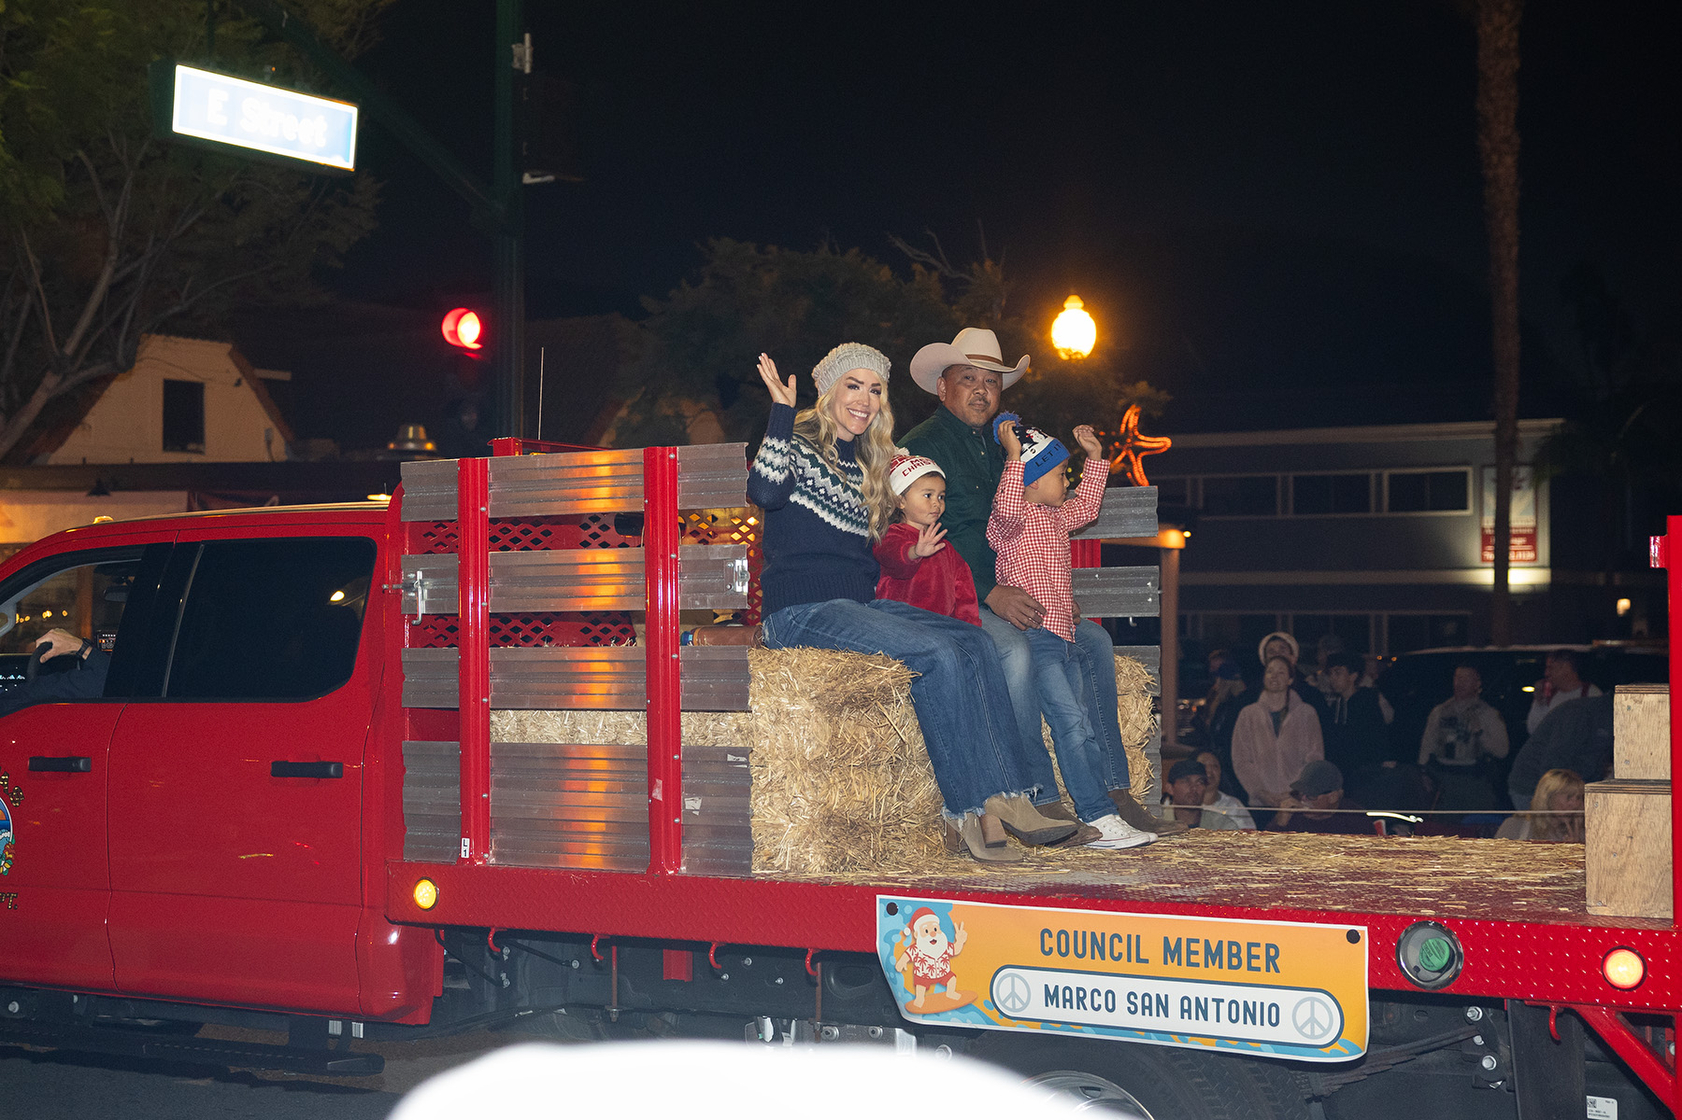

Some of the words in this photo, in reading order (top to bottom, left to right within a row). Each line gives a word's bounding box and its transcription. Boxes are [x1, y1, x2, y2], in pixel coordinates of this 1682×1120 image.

[206, 87, 230, 126] E
[239, 97, 328, 148] Street
[1035, 451, 1054, 467] LET
[1053, 443, 1062, 451] IT
[1040, 928, 1150, 964] COUNCIL
[1163, 936, 1281, 973] MEMBER
[1044, 984, 1117, 1013] MARCO
[1127, 991, 1169, 1018] SAN
[1180, 996, 1280, 1028] ANTONIO
